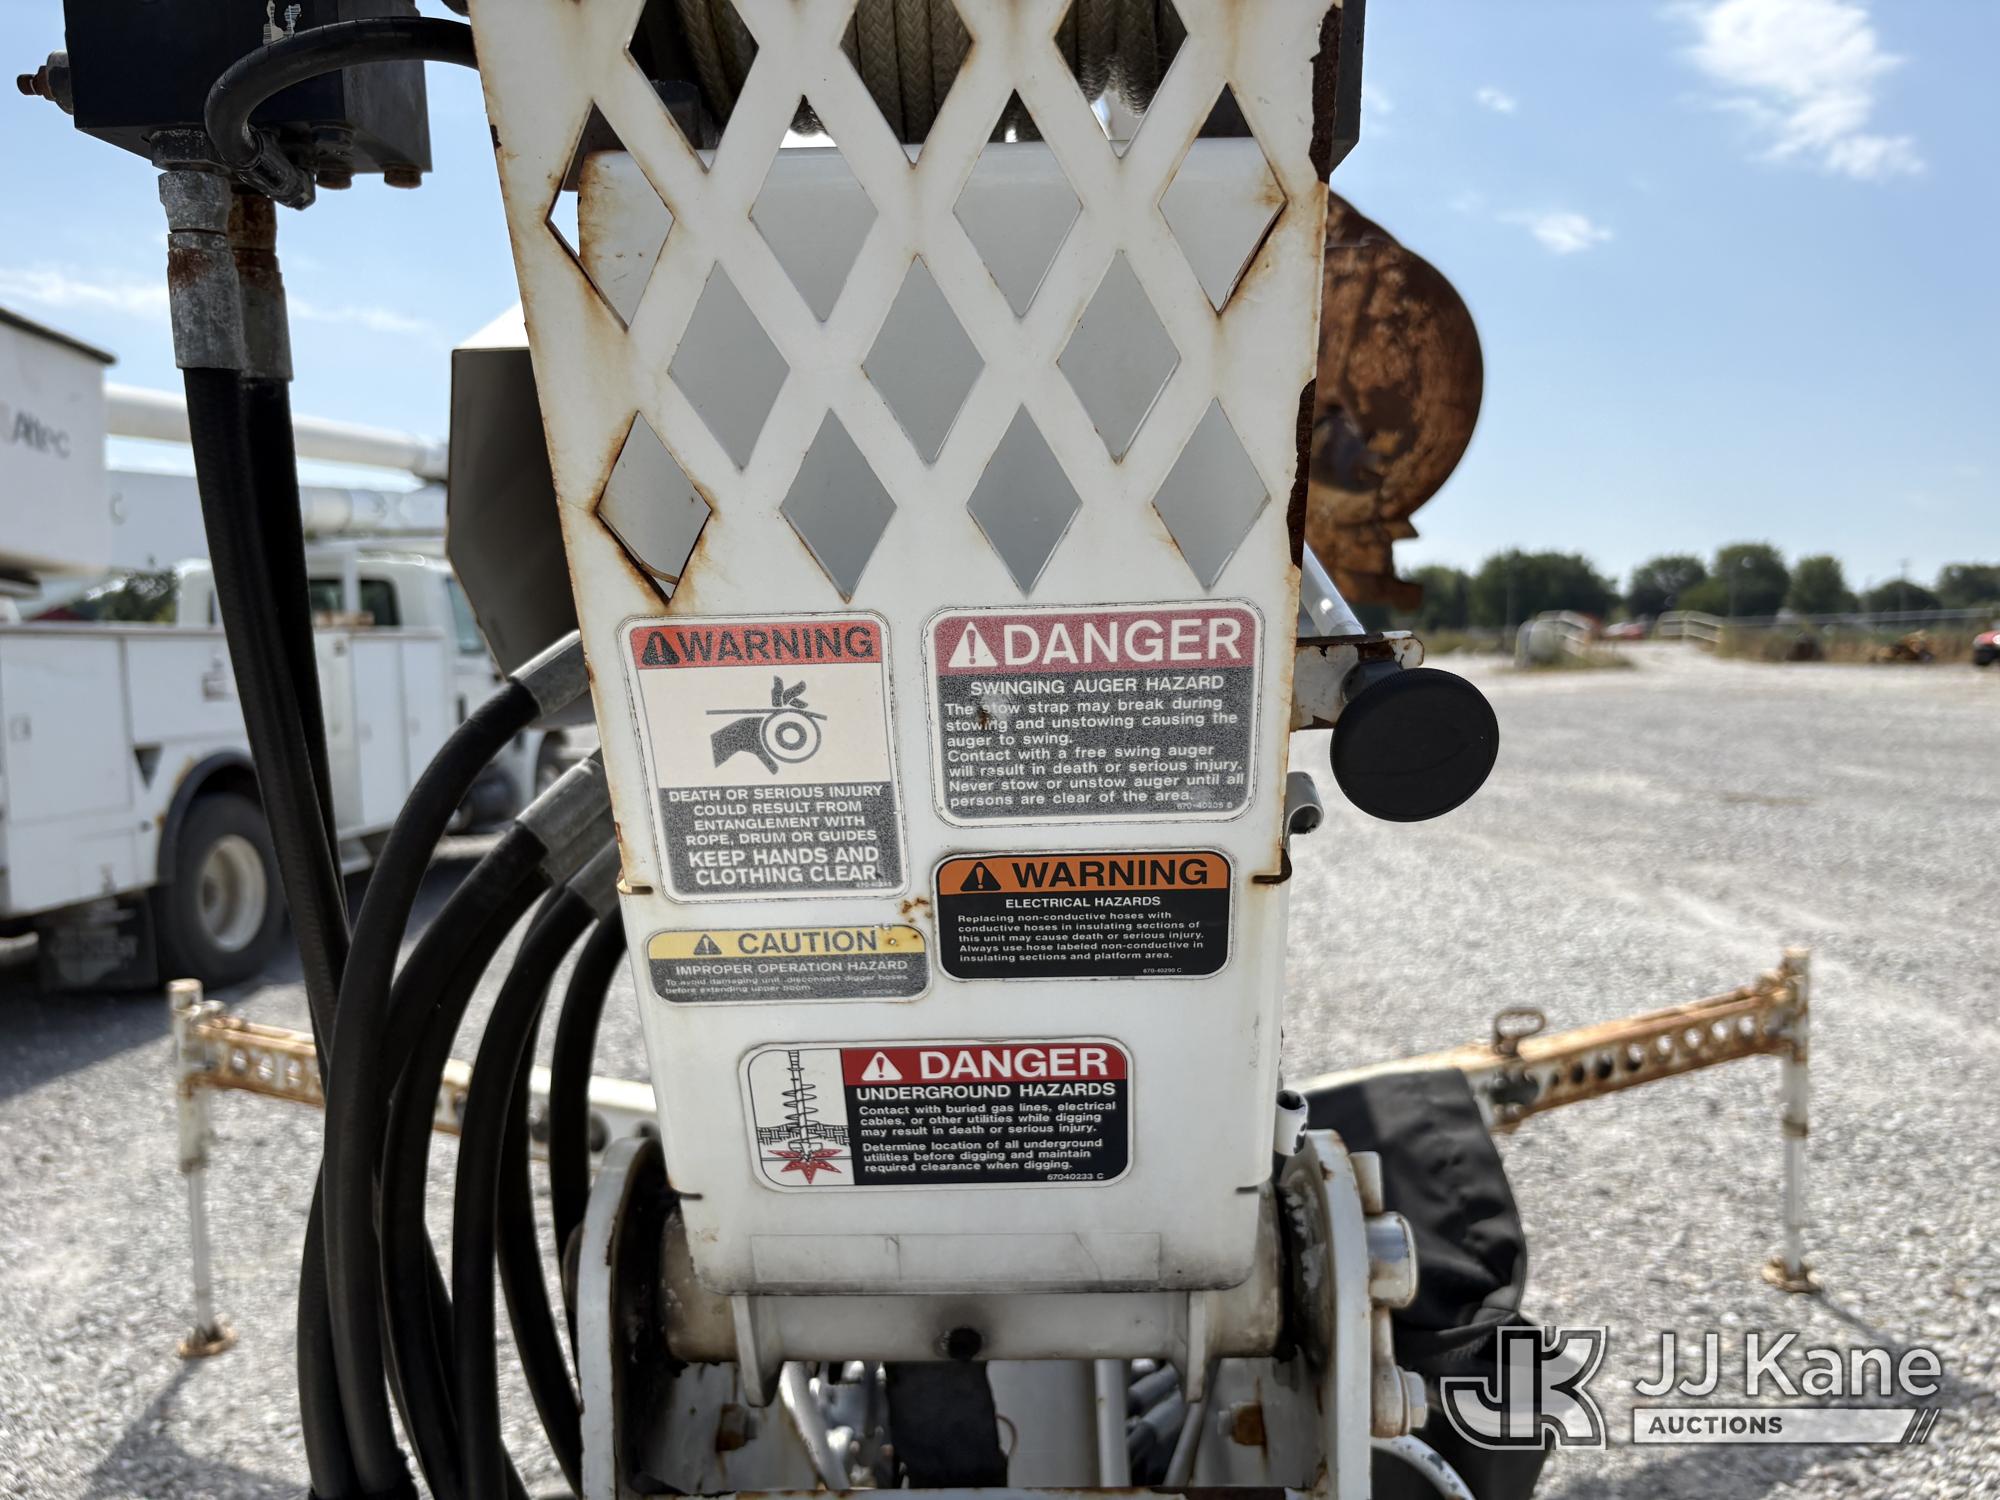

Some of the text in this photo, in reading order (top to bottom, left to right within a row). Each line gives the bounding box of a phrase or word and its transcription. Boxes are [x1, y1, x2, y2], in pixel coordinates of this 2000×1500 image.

[677, 626, 873, 662] WARNING
[1004, 617, 1241, 666] DANGER
[970, 676, 1223, 696] SWINGING AUGER HAZARD
[945, 697, 1222, 716] The stow strap may break during
[946, 713, 1237, 733] stowing and unstowing causing the
[948, 732, 1072, 749] auger to swing.
[948, 746, 1214, 763] Contact with a free swing auger
[950, 758, 1242, 777] will result in death or serious injury.
[950, 773, 1244, 792] Never stow or unstow auger until all
[669, 785, 883, 802] DEATH OR SERIOUS INJURY
[950, 790, 1193, 809] persons are clear of the area.
[694, 801, 861, 816] COULD RESULT FROM
[695, 816, 865, 831] ENTANGLEMENT WITH
[686, 830, 877, 846] ROPE, DRUM OR GUIDES
[689, 846, 878, 867] KEEP HANDS AND
[696, 865, 877, 885] CLOTHING CLEAR
[1012, 859, 1208, 888] WARNING
[1005, 896, 1161, 908] ELECTRICAL HAZARDS
[958, 914, 1014, 924] Replacing
[1018, 913, 1106, 921] non-conductive
[1110, 912, 1144, 920] hoses
[1076, 923, 1132, 931] insulating
[1169, 931, 1204, 940] injury.
[738, 930, 878, 954] CAUTION
[960, 945, 999, 953] Always
[1101, 941, 1189, 949] non-conductive
[960, 955, 1015, 963] insulating
[1095, 952, 1141, 960] platform
[676, 960, 908, 975] IMPROPER OPERATION HAZARD
[920, 1048, 1108, 1080] DANGER
[856, 1082, 1116, 1100] UNDERGROUND HAZARDS
[859, 1101, 1116, 1115] Contact with buried gas lines, electrical
[860, 1113, 1102, 1126] cables, or other utilities while digging
[861, 1129, 887, 1137] may
[892, 1127, 928, 1135] result
[932, 1126, 944, 1134] in
[949, 1125, 984, 1134] death
[1008, 1124, 1053, 1133] serious
[1059, 1124, 1096, 1133] injury.
[862, 1139, 1102, 1152] Determine location of all underground
[864, 1149, 1091, 1162] utilities before digging and maintain
[865, 1160, 1073, 1173] required clearance when digging.
